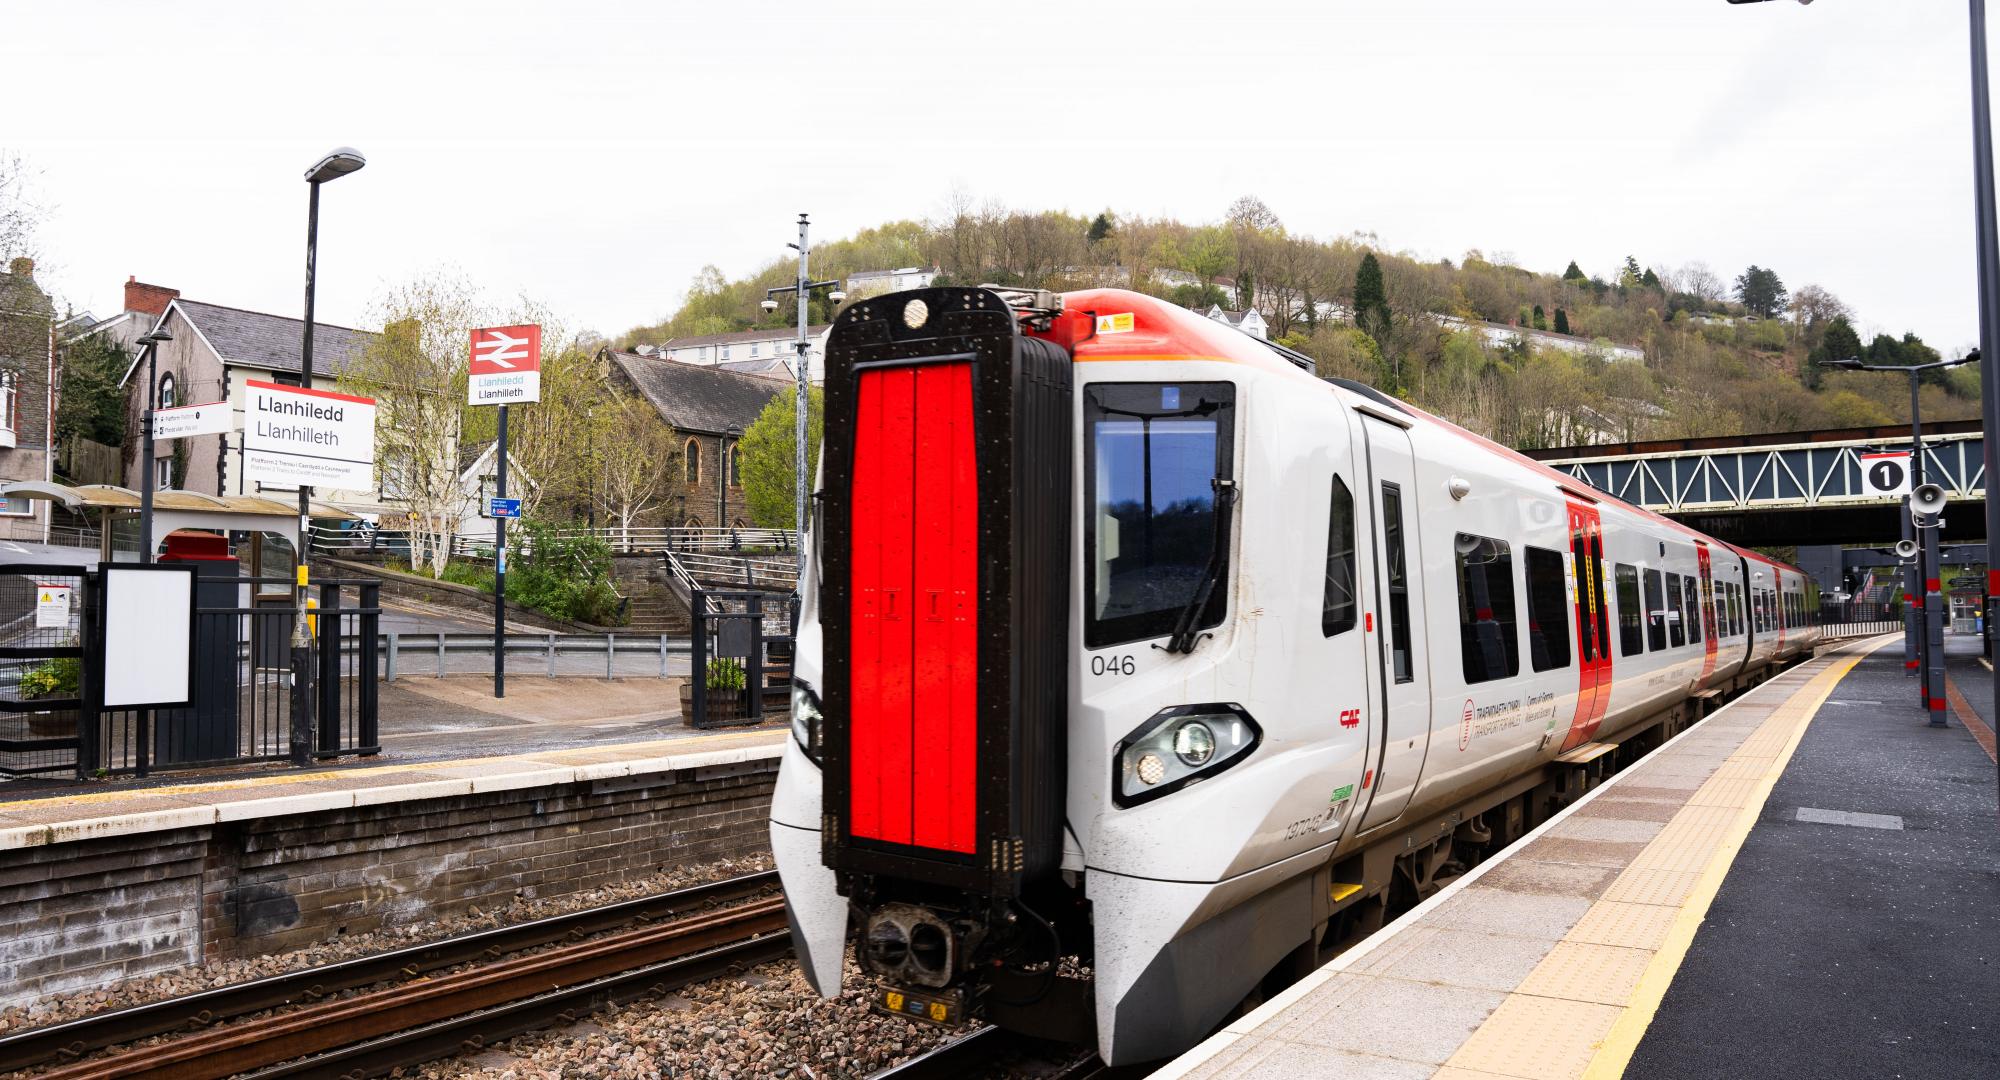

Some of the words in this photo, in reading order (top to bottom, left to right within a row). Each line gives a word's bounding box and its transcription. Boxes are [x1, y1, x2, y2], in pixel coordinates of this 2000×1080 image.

[478, 376, 524, 387] Llanhiledd
[478, 388, 523, 399] Llanhilleth
[258, 395, 343, 422] Llanhiledd
[257, 421, 339, 446] Llanhilleth
[1880, 465, 1890, 487] 1
[1091, 655, 1135, 676] 046
[1340, 709, 1360, 729] CAF
[1284, 814, 1322, 841] 197046
